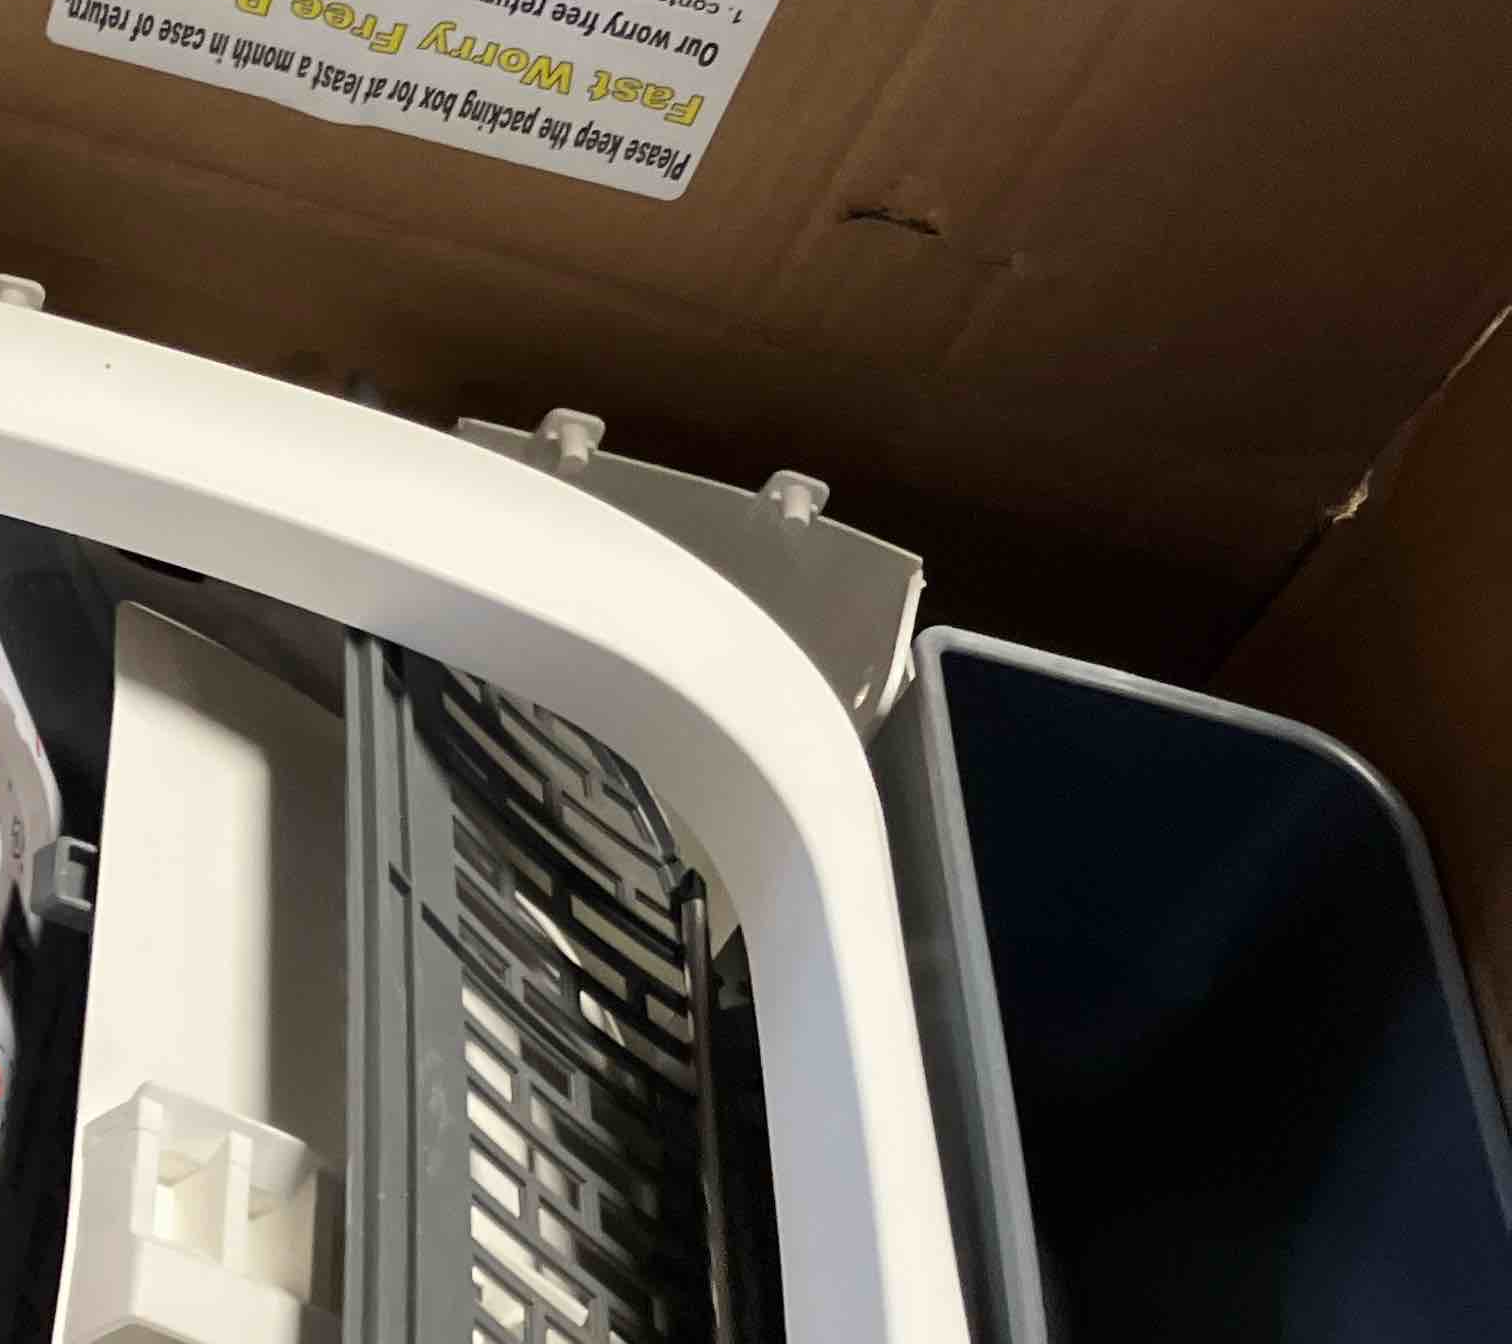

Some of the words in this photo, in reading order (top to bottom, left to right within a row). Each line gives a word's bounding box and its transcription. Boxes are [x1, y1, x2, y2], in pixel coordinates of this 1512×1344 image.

[129, 12, 154, 41] of
[551, 3, 599, 36] free
[601, 11, 670, 49] worry
[728, 7, 742, 23] 1.
[158, 19, 205, 49] case
[209, 32, 229, 63] in
[673, 35, 718, 66] Our
[232, 38, 295, 72] month
[296, 55, 311, 77] a
[416, 20, 573, 95] Worry
[310, 60, 363, 103] least
[362, 77, 387, 103] at
[386, 79, 418, 111] for
[586, 69, 704, 127] Fast
[418, 86, 458, 121] box
[457, 89, 541, 134] packing
[538, 117, 572, 149] the
[573, 120, 624, 163] keep
[623, 139, 691, 180] Please
